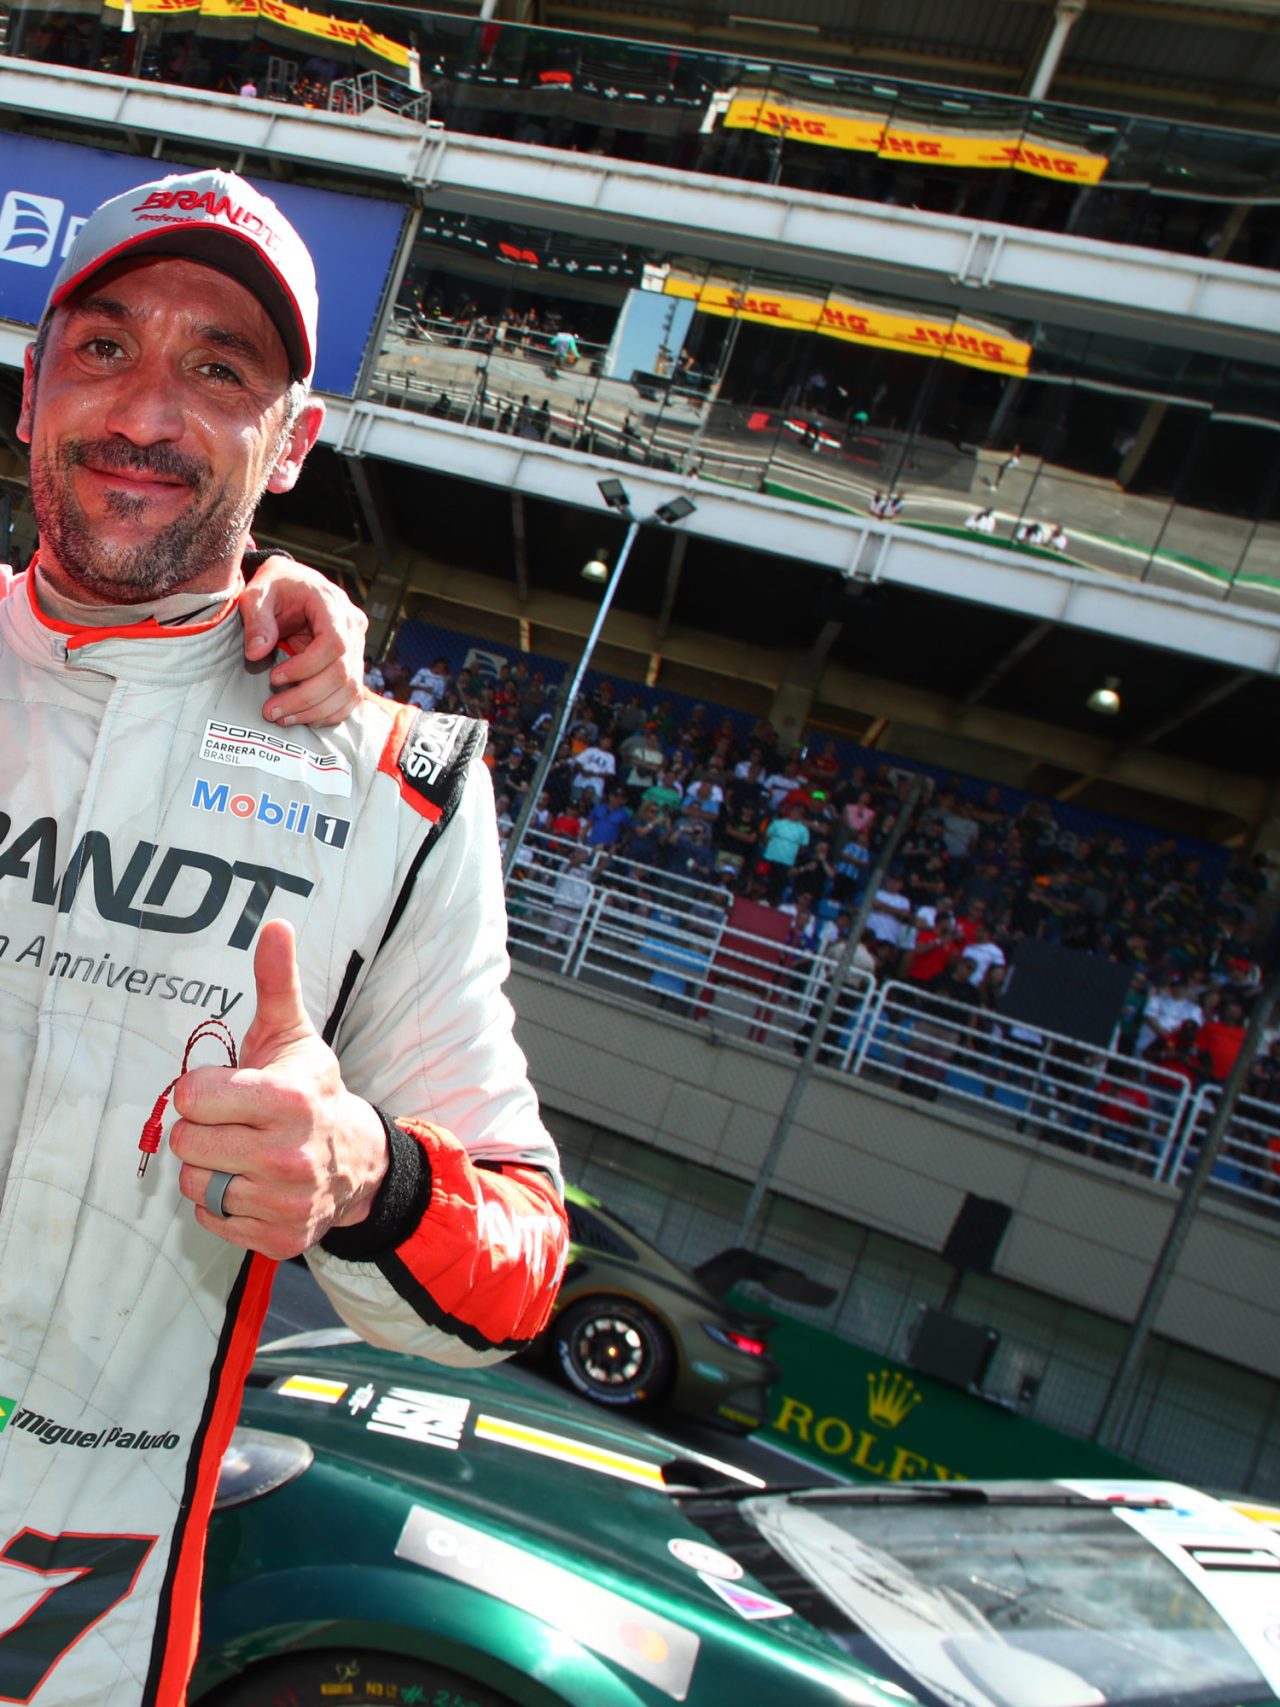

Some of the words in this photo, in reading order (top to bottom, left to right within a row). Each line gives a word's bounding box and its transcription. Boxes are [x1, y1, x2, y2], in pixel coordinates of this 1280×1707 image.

[132, 190, 281, 247] BRANDT
[203, 749, 241, 764] BRASIL
[205, 739, 256, 756] CARRERA
[258, 750, 281, 763] CUP
[209, 722, 338, 766] PORSCHE
[192, 778, 311, 835] Mobil
[15, 935, 243, 1019] Anniversary
[11, 1407, 106, 1449] Miguel
[103, 1427, 180, 1450] Paludo
